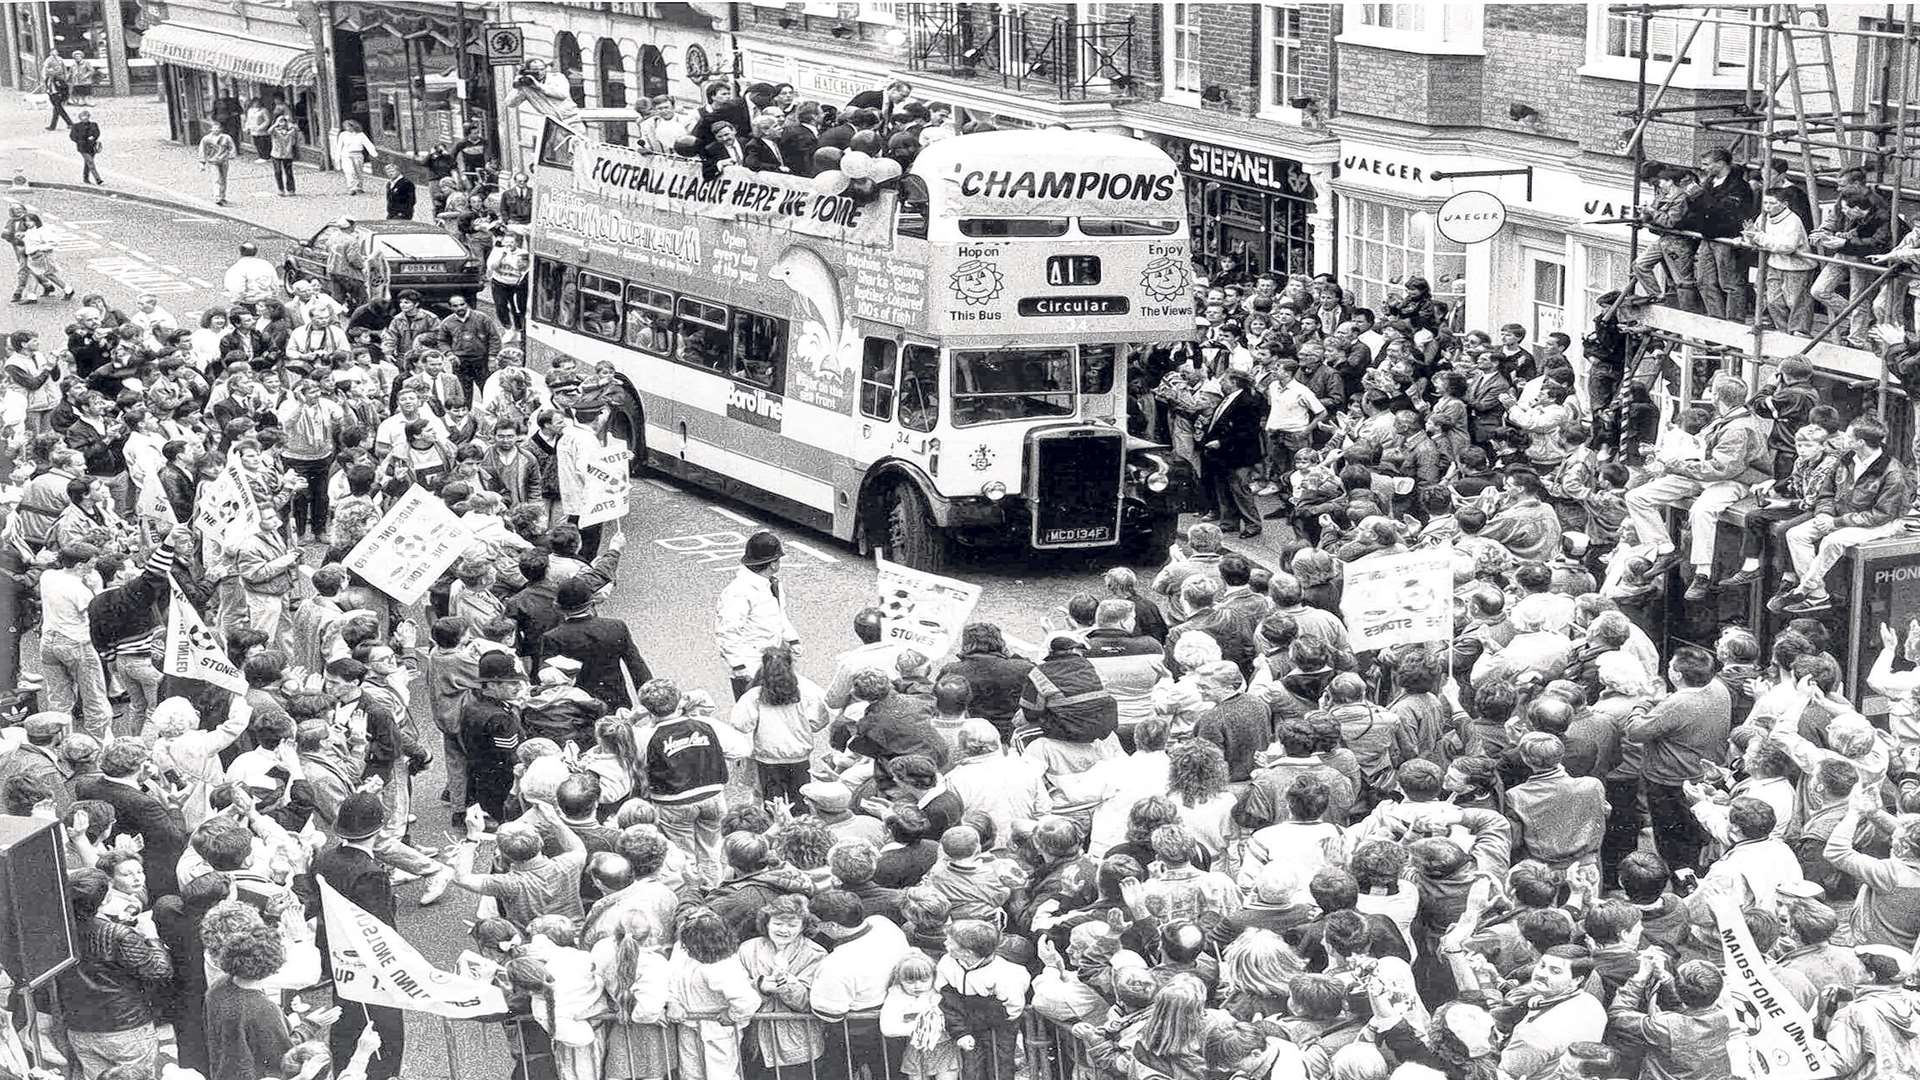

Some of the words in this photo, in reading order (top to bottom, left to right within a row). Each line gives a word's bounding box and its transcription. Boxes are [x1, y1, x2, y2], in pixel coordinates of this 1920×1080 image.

[1189, 142, 1281, 189] STEFANEL
[1344, 155, 1423, 183] JAEGER
[731, 180, 780, 212] HERE
[778, 189, 808, 217] WE
[1444, 212, 1499, 222] JAEGER
[1584, 200, 1634, 219] JAE
[722, 229, 747, 250] Open
[713, 248, 741, 268] every
[741, 250, 759, 271] day
[958, 247, 983, 259] Hop
[984, 248, 999, 258] on
[1148, 244, 1184, 258] Enjoy
[712, 260, 723, 274] of
[723, 261, 739, 280] the
[886, 259, 925, 281] Sealions
[857, 270, 889, 289] Sharks
[893, 278, 920, 295] Seals
[950, 311, 976, 321] This
[979, 310, 1002, 321] Bus
[1036, 301, 1109, 313] Circular
[1140, 306, 1160, 317] The
[1161, 305, 1193, 317] Views
[896, 431, 910, 444] 34
[154, 503, 167, 513] UP
[201, 510, 218, 527] THE
[1875, 566, 1920, 584] PHON
[890, 627, 935, 647] STONES
[200, 657, 240, 679] STONES
[334, 967, 355, 985] UP
[1721, 928, 1786, 1020] MAIDSTONE
[1782, 1021, 1821, 1073] UNITED
